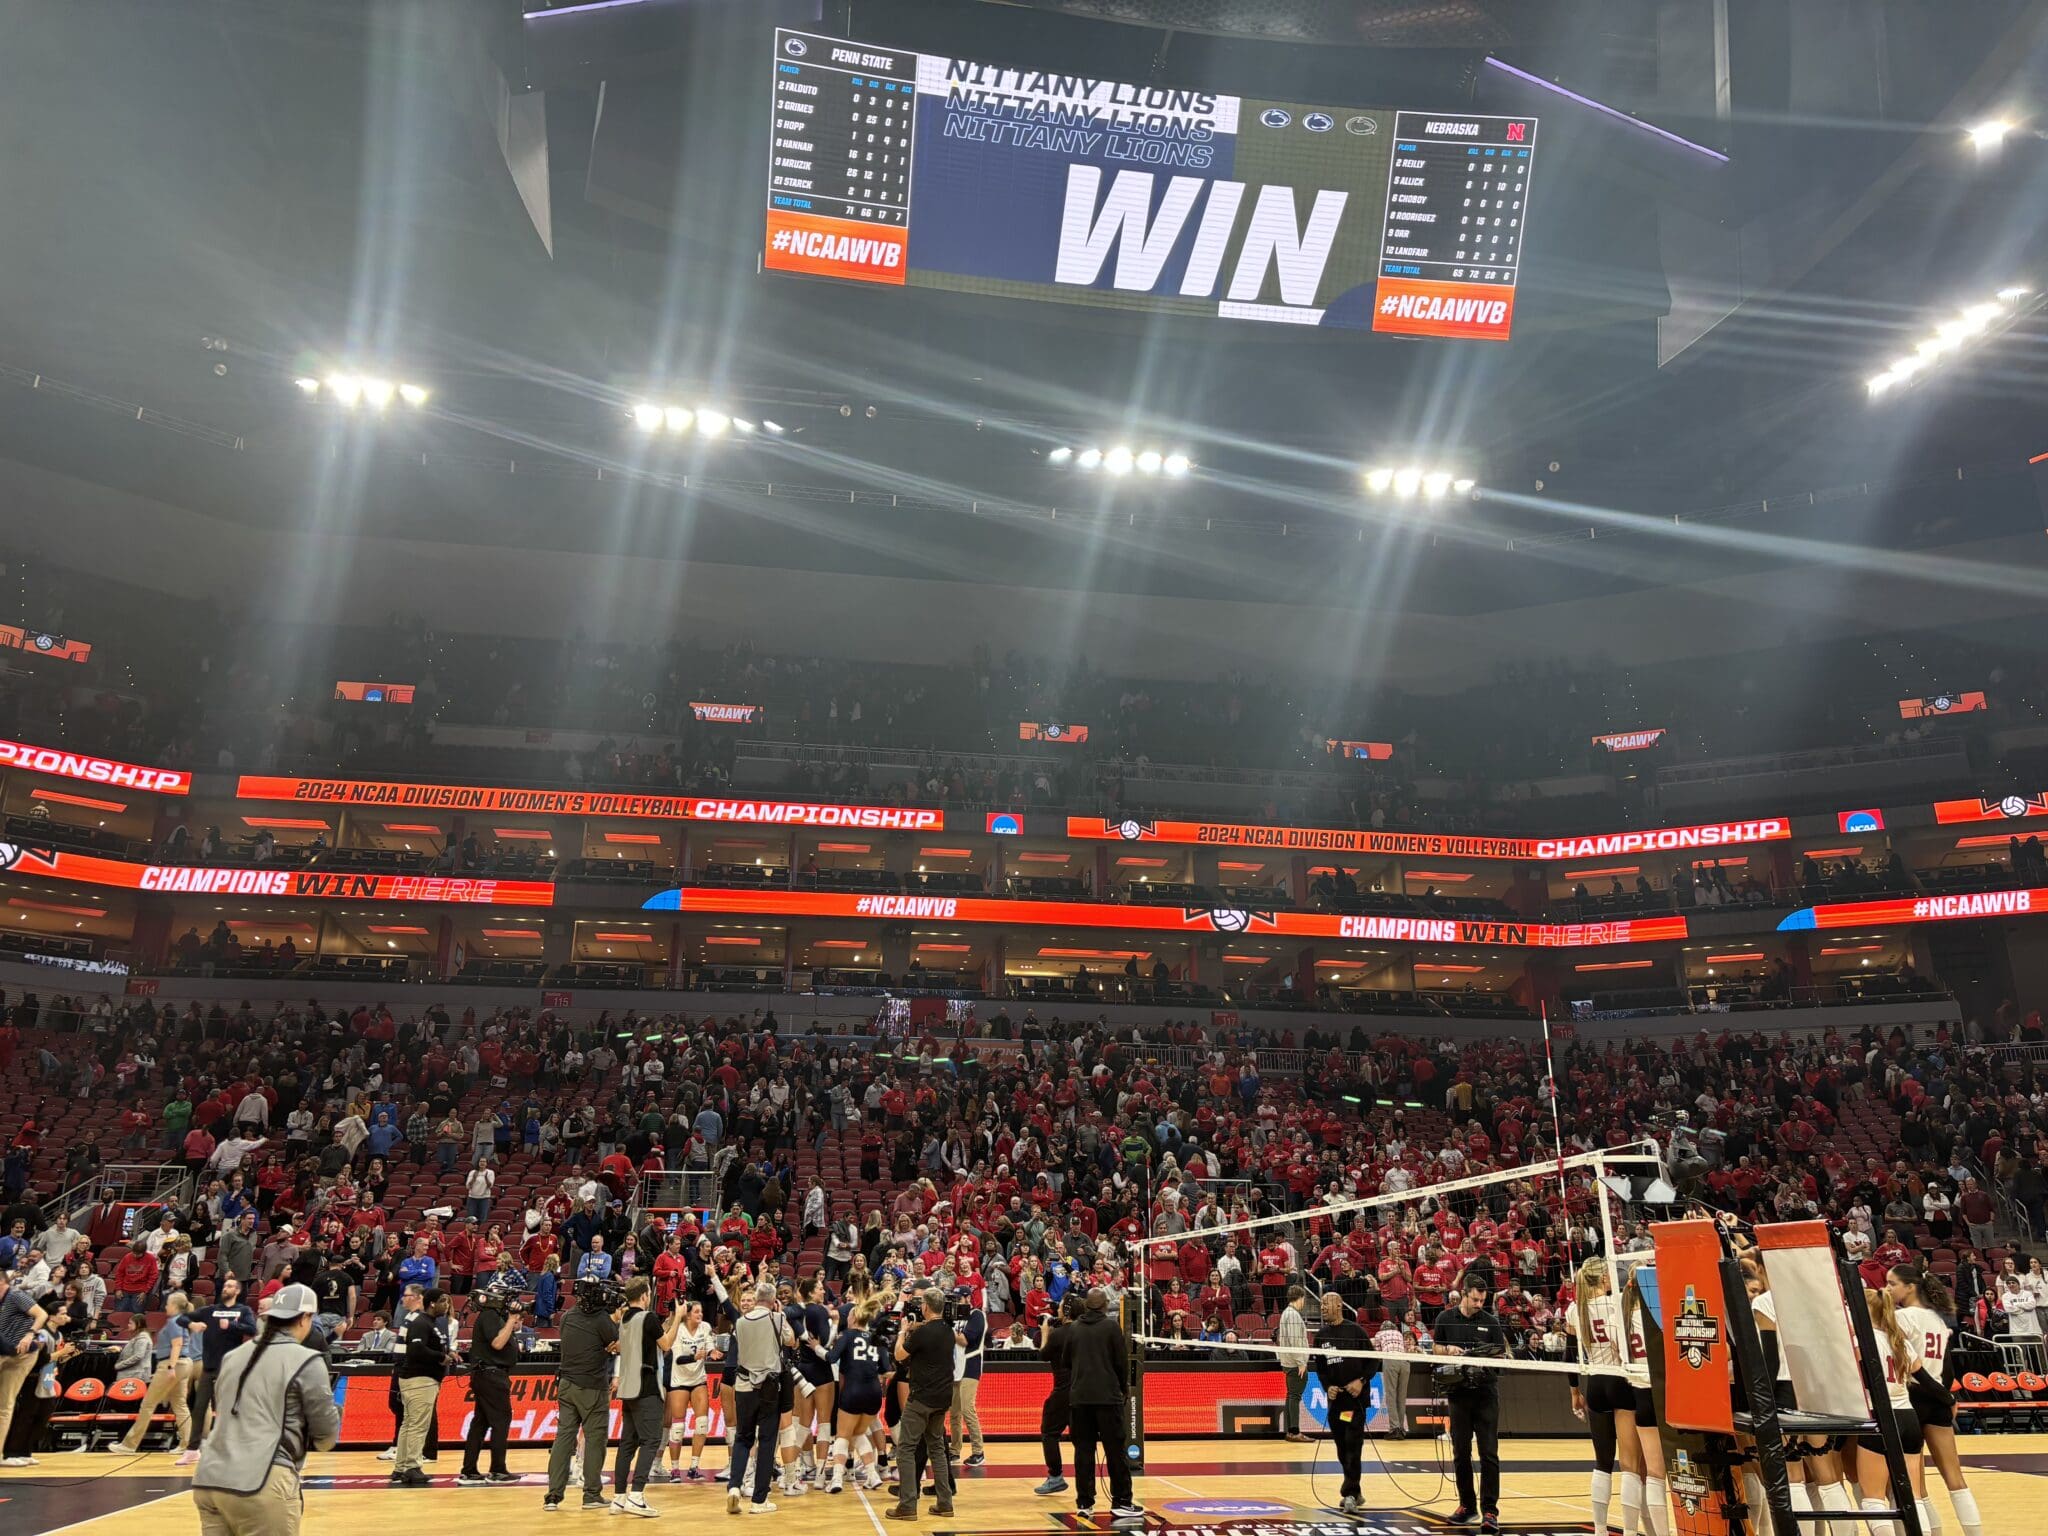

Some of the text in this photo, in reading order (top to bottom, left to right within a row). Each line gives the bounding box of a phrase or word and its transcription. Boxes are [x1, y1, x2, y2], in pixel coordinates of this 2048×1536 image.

[832, 48, 893, 70] PENN STATE
[778, 81, 785, 90] 2
[853, 94, 860, 103] 0
[870, 96, 876, 106] 3
[886, 99, 893, 108] 0
[902, 102, 909, 111] 2
[945, 59, 1217, 115] NITTANY LIONS
[777, 100, 784, 109] 3
[784, 101, 814, 114] GRIMES
[852, 112, 859, 122] 0
[866, 115, 878, 125] 25
[885, 118, 892, 127] 0
[945, 86, 1215, 142] NITTANY LIONS
[776, 119, 783, 128] 5
[784, 120, 805, 131] HOPP
[868, 134, 875, 143] 0
[900, 138, 907, 147] 0
[944, 113, 1214, 168] NITTANY LIONS
[1425, 122, 1525, 141] NEBRASKA N
[776, 138, 783, 147] 8
[783, 139, 813, 152] HANNAH
[848, 150, 858, 159] 16
[866, 152, 873, 161] 5
[774, 157, 781, 166] 9
[864, 171, 873, 180] 12
[1396, 159, 1402, 168] 2
[1402, 160, 1426, 169] REILLY
[1468, 163, 1475, 172] 0
[1483, 164, 1492, 173] 15
[1518, 166, 1525, 174] 0
[774, 176, 783, 185] 21
[784, 177, 813, 190] STARCK
[848, 187, 855, 196] 2
[864, 189, 871, 198] 11
[880, 192, 887, 200] 2
[1394, 176, 1400, 185] 5
[1400, 178, 1425, 187] ALLICK
[1497, 183, 1507, 191] 10
[1515, 183, 1522, 192] 0
[774, 196, 902, 221] TEAM TOTAL 71 66 17 7
[1398, 194, 1428, 205] CHOBOY
[1464, 199, 1471, 207] 0
[1496, 200, 1503, 209] 0
[1512, 201, 1520, 210] 0
[1396, 212, 1437, 223] RODRIGUEZ
[1461, 216, 1468, 225] 0
[1476, 217, 1486, 226] 15
[1494, 218, 1501, 227] 0
[1510, 218, 1518, 227] 0
[1055, 164, 1349, 305] WIN
[1388, 228, 1394, 237] 9
[1394, 230, 1410, 238] ORR
[1459, 234, 1466, 242] 0
[1475, 234, 1482, 243] 5
[1492, 236, 1499, 244] 0
[772, 230, 902, 268] #NCAAWVB
[1386, 246, 1513, 262] 12 LANDFAIR 10 2 3 0
[1384, 265, 1401, 273] TEAM
[1402, 266, 1420, 275] TOTAL
[1452, 269, 1464, 278] 65
[1469, 270, 1480, 279] 72
[1504, 272, 1510, 281] 6
[1380, 294, 1507, 324] #NCAAWVB
[295, 782, 936, 828] 2024 NCAA DIVISION I WOMEN'S VOLLEYBALL CHAMPIONSHIP
[1198, 821, 1780, 859] 2024 NCAA DIVISION I WOMEN'S VOLLEYBALL CHAMPIONSHIP
[140, 866, 497, 903] CHAMPIONS WIN HERE
[856, 896, 958, 918] #NCAAWVB
[1914, 892, 2030, 917] #NCAAWVB
[1340, 916, 1631, 946] CHAMPIONS WIN HERE
[554, 996, 569, 1007] 115
[1560, 1030, 1574, 1039] 118
[853, 1337, 879, 1362] 24
[1925, 1332, 1943, 1360] 21
[1310, 1388, 1381, 1409] NA
